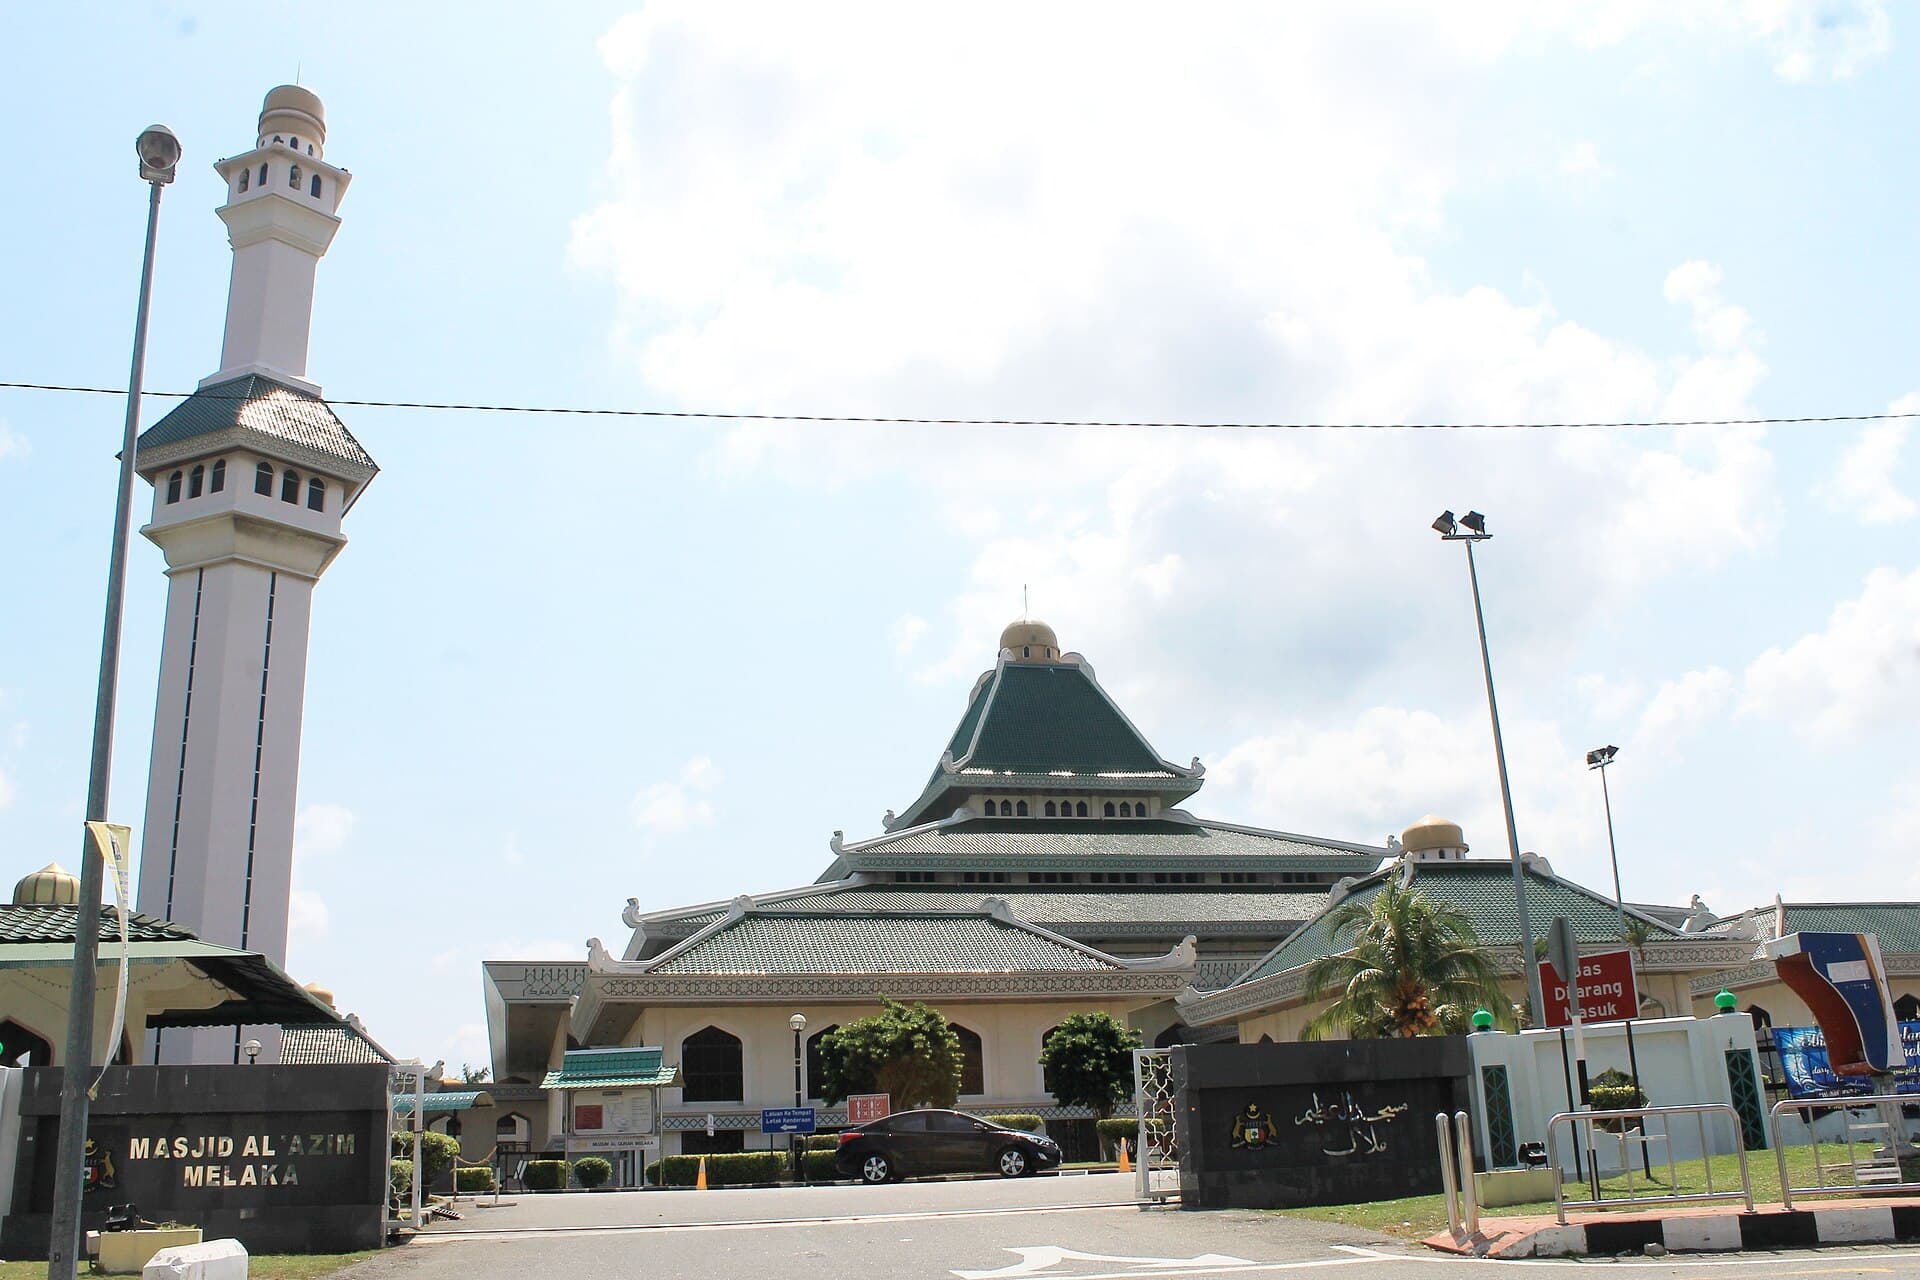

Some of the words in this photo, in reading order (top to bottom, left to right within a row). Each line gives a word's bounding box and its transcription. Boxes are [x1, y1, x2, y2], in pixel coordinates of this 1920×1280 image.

[1554, 981, 1623, 1001] Diarang
[129, 1135, 234, 1160] MASJID
[241, 1135, 276, 1157] AL
[184, 1164, 298, 1188] MELAKA
